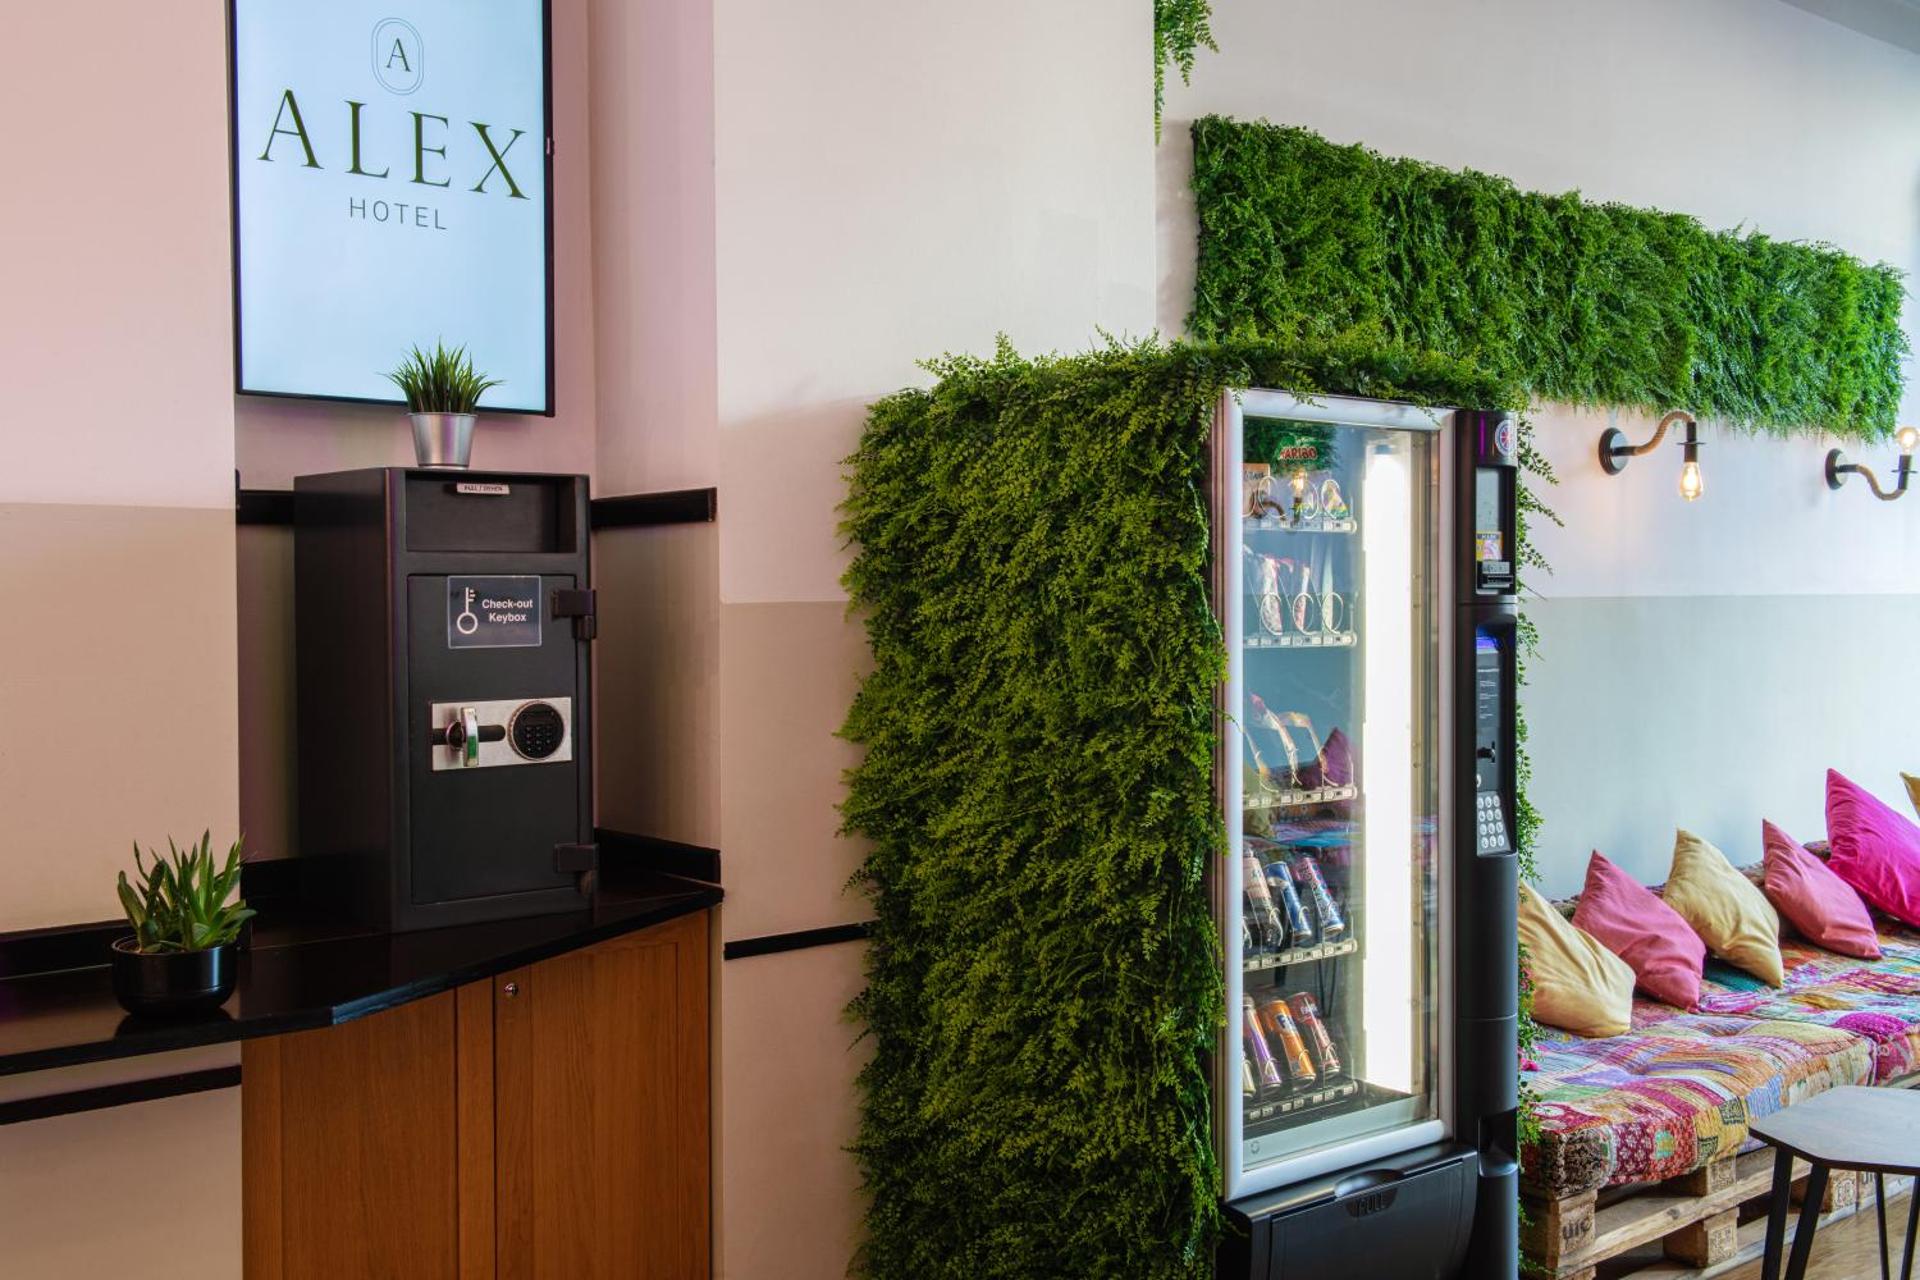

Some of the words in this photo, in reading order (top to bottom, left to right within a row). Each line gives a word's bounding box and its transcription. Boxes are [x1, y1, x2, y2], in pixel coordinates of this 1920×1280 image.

[386, 37, 412, 72] A
[257, 88, 531, 201] ALEX
[349, 196, 448, 231] HOTEL
[481, 598, 534, 610] Check-out
[488, 611, 527, 624] Keybox
